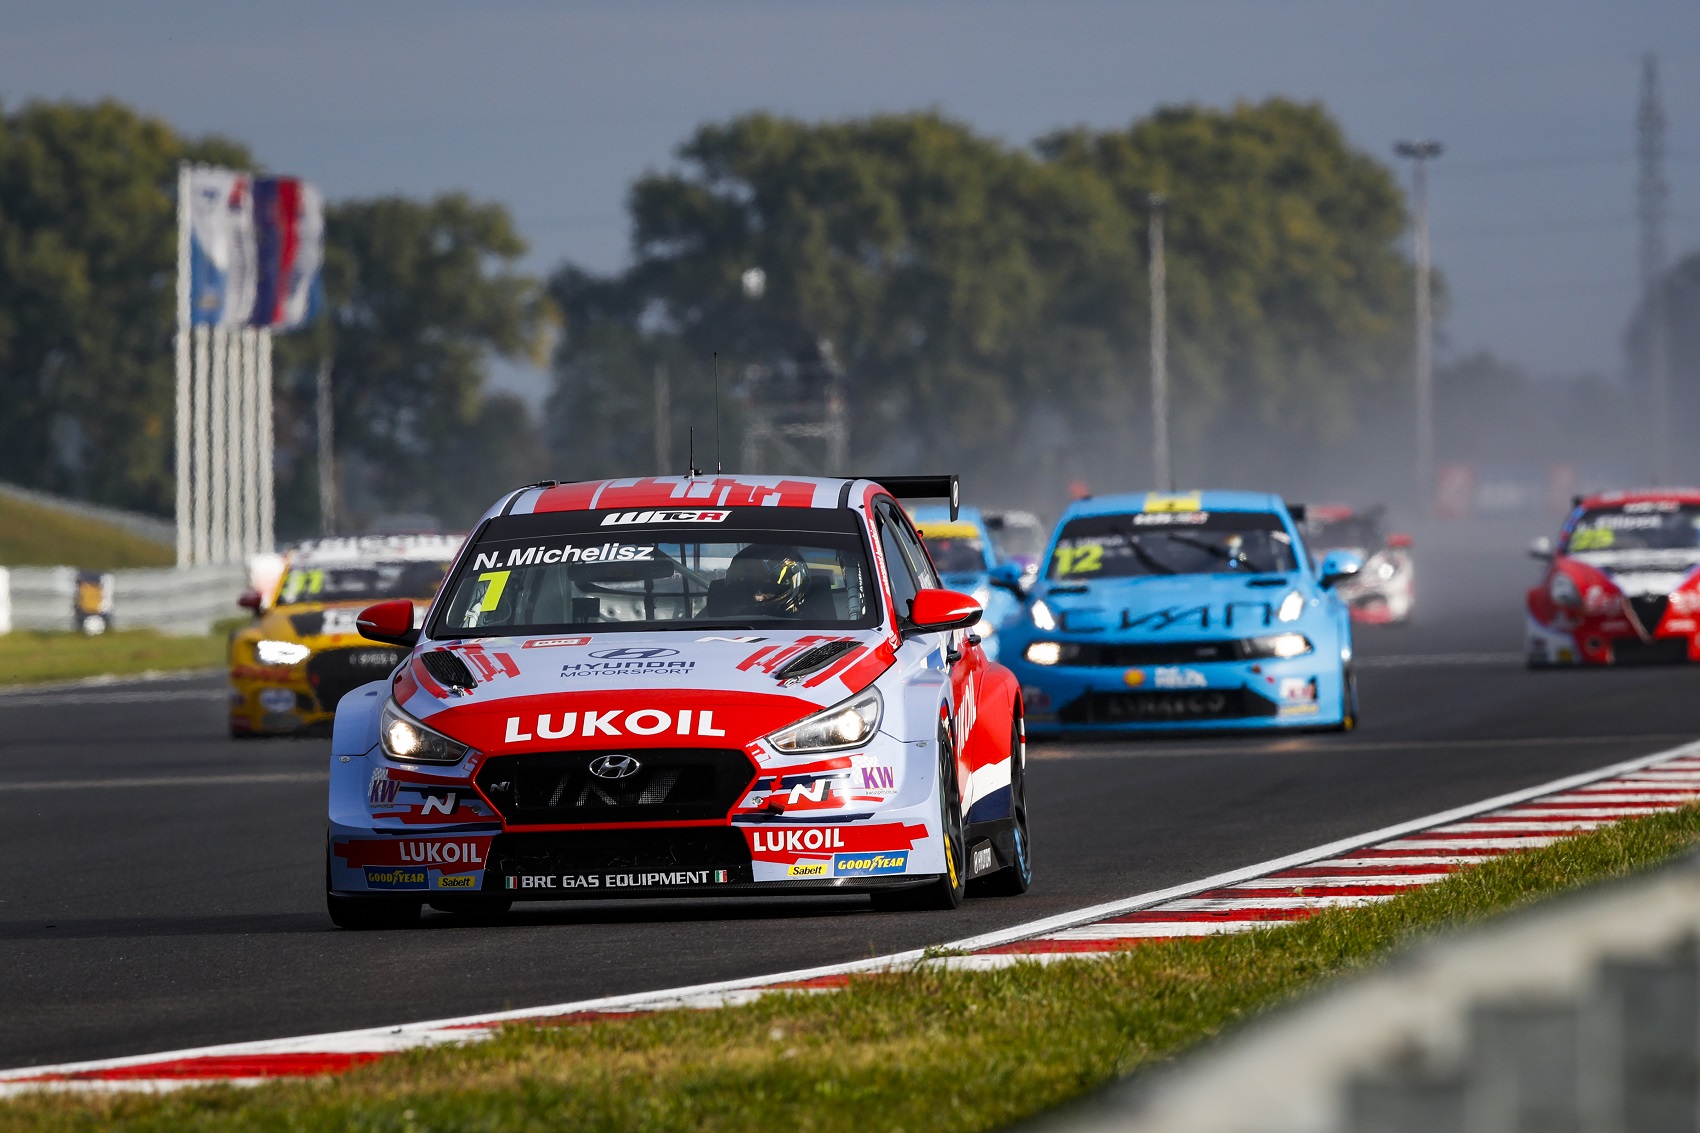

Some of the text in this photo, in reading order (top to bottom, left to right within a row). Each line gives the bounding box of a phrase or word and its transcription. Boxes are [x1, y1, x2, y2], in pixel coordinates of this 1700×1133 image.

[600, 511, 730, 526] WTCR
[473, 543, 654, 571] N. Michelisz
[1055, 544, 1104, 575] 12
[478, 570, 511, 612] 1
[560, 668, 694, 678] MOTORSPORT
[562, 661, 696, 671] HYUNDAI
[504, 709, 726, 743] LUKOIL
[861, 766, 894, 789] KW
[370, 779, 401, 803] KW
[753, 828, 845, 852] LUKOIL
[399, 842, 482, 863] LUKOIL
[792, 866, 823, 876] Sabelt
[837, 855, 905, 872] GOODYEAR
[368, 870, 425, 885] GOODYEAR
[442, 877, 471, 888] Sabelt
[521, 871, 710, 888] BRC GAS EQUIPMENT
